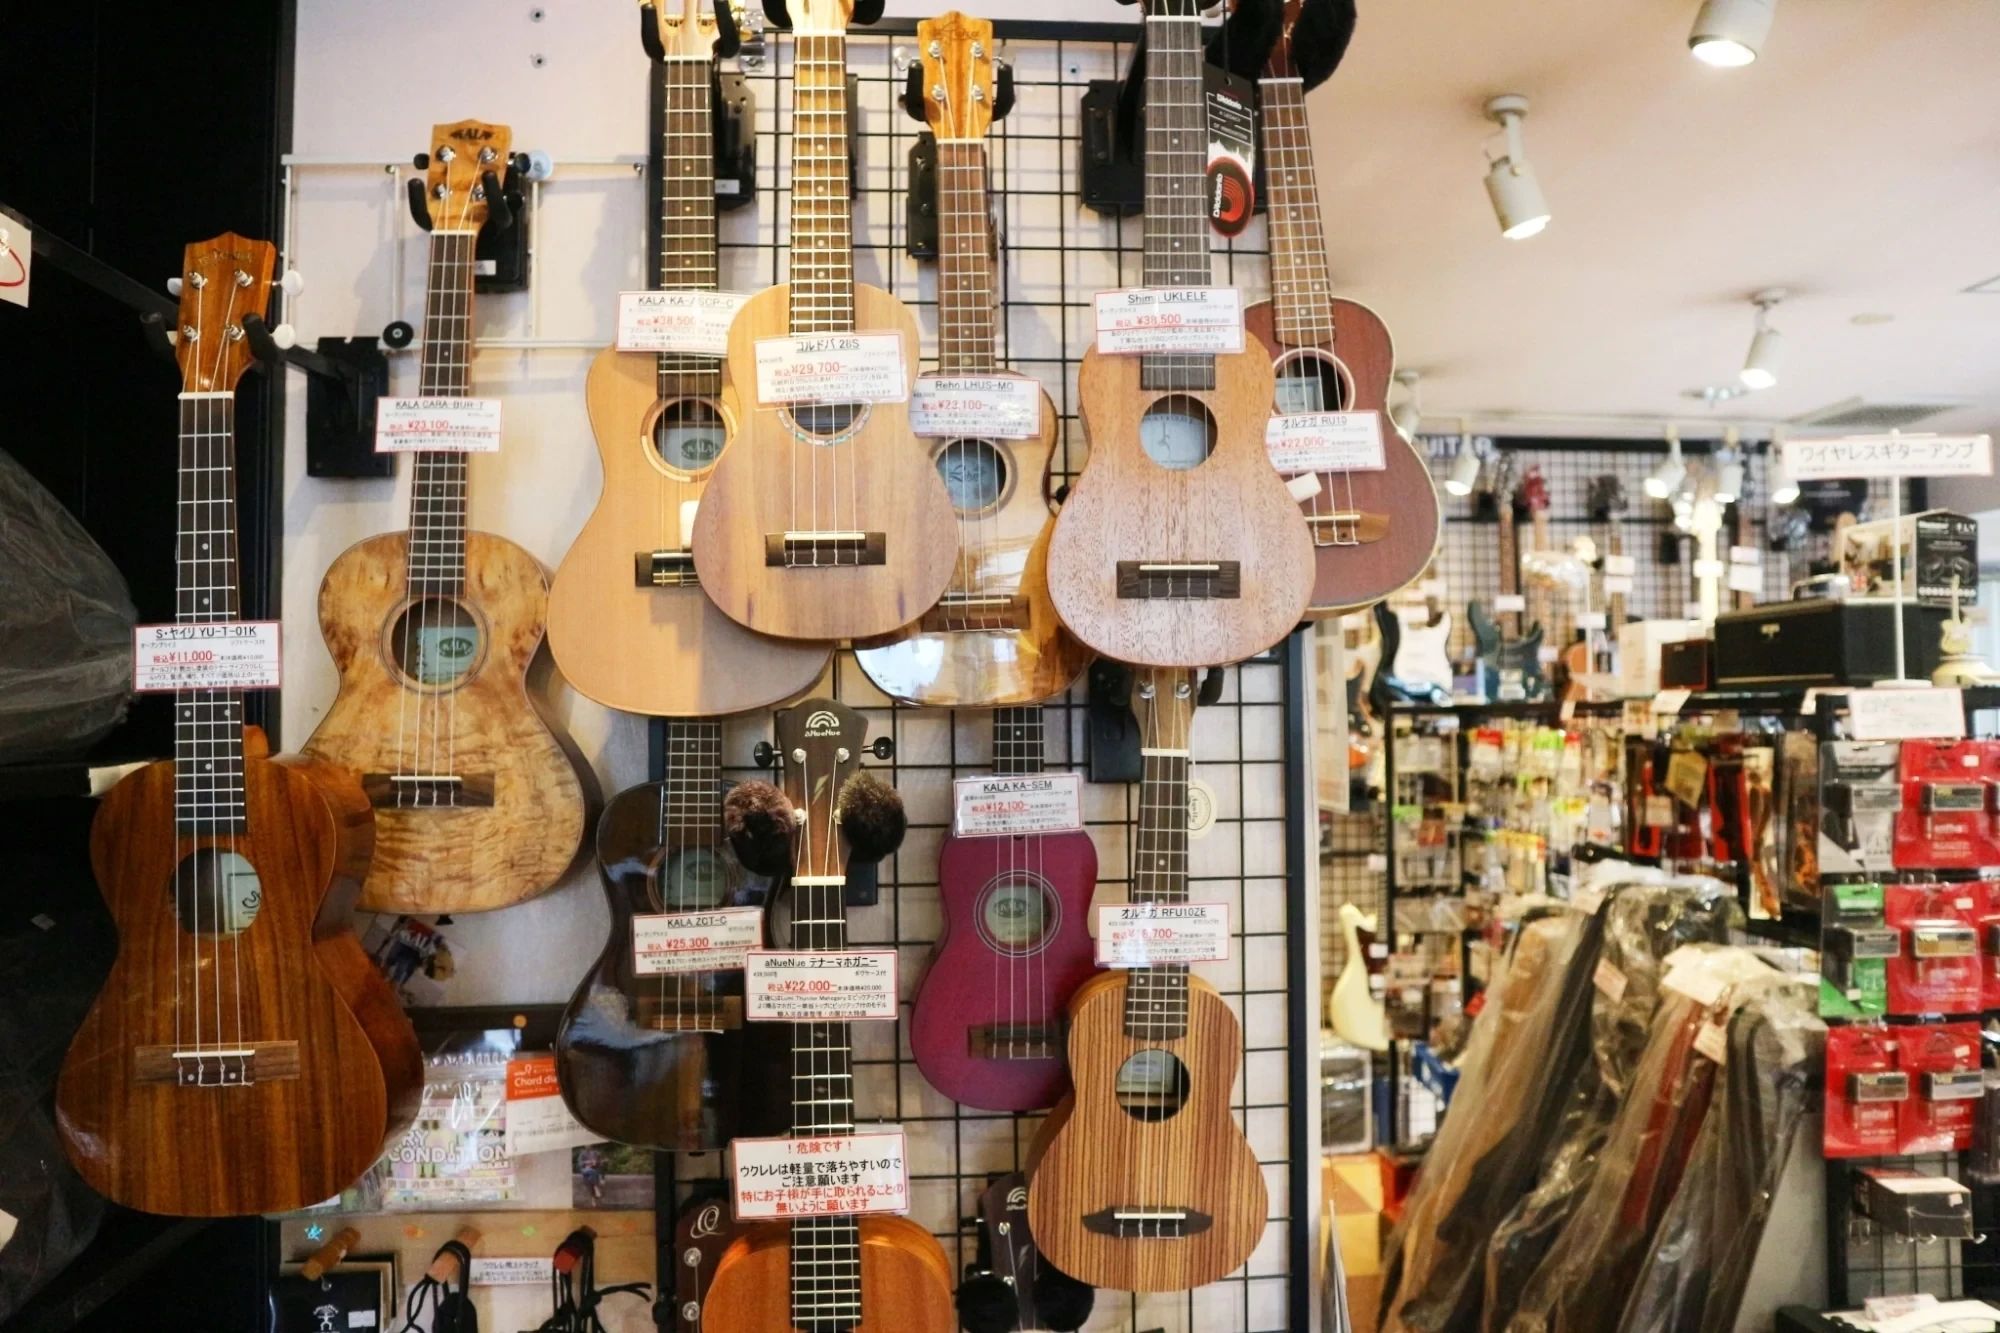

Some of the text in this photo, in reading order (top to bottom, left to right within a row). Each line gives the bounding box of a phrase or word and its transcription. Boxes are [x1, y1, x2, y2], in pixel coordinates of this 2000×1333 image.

[638, 296, 665, 305] KALA
[200, 626, 257, 637] YU-T-01K
[983, 780, 1053, 792] KALA KA-SEM
[1161, 907, 1207, 917] RFU10ZE
[667, 918, 693, 928] KALA
[666, 937, 709, 949] ¥25,300
[809, 956, 878, 967] テナーマホガニー
[514, 1075, 542, 1088] Chord
[740, 1158, 901, 1177] ウクレレは軽量で落ちやすいので
[782, 1173, 861, 1187] ご注意願います
[776, 1198, 870, 1214] 無いように願います
